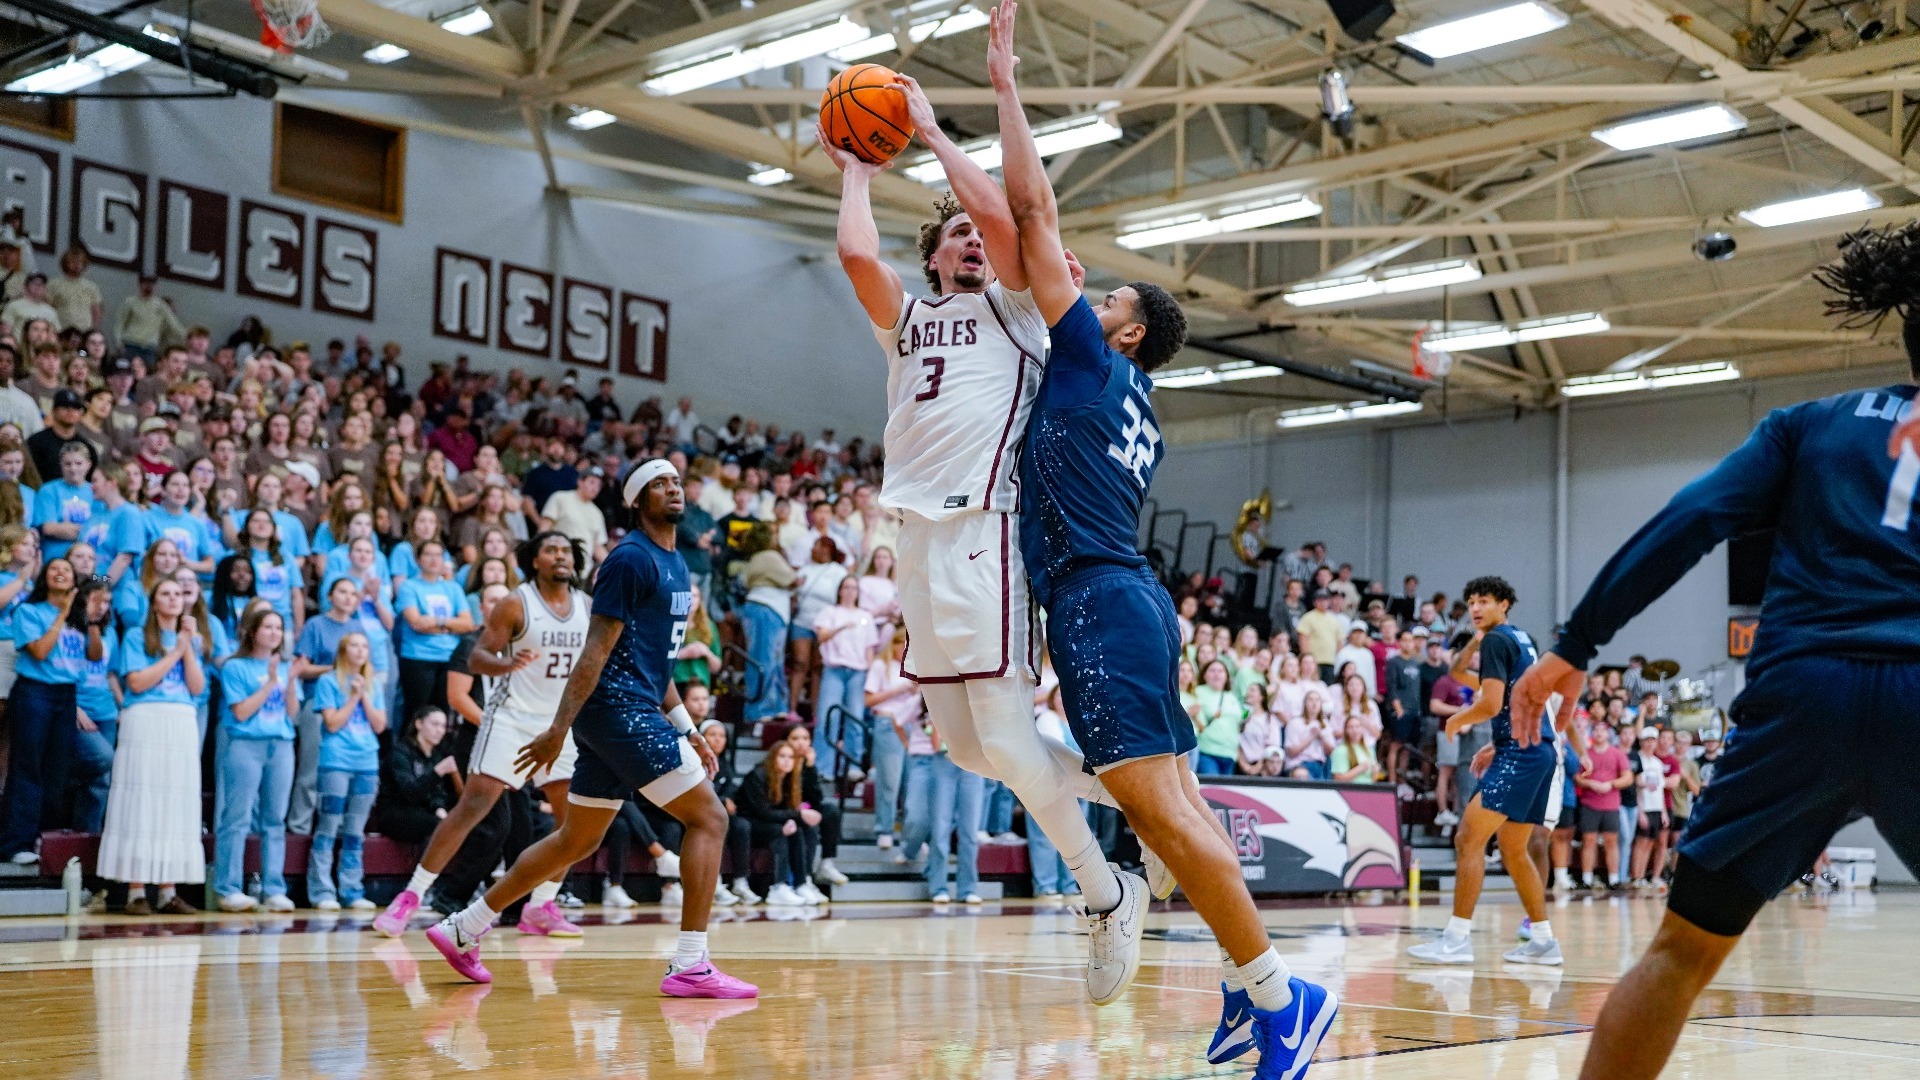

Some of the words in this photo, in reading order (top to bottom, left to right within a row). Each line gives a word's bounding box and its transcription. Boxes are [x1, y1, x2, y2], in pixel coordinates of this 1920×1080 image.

[867, 129, 900, 157] NCAA
[440, 252, 666, 374] NEST
[897, 318, 977, 357] EAGLES
[915, 356, 945, 402] 3
[1107, 394, 1161, 489] 32
[541, 630, 582, 648] EAGLES
[667, 621, 688, 659] 5
[545, 652, 573, 679] 23
